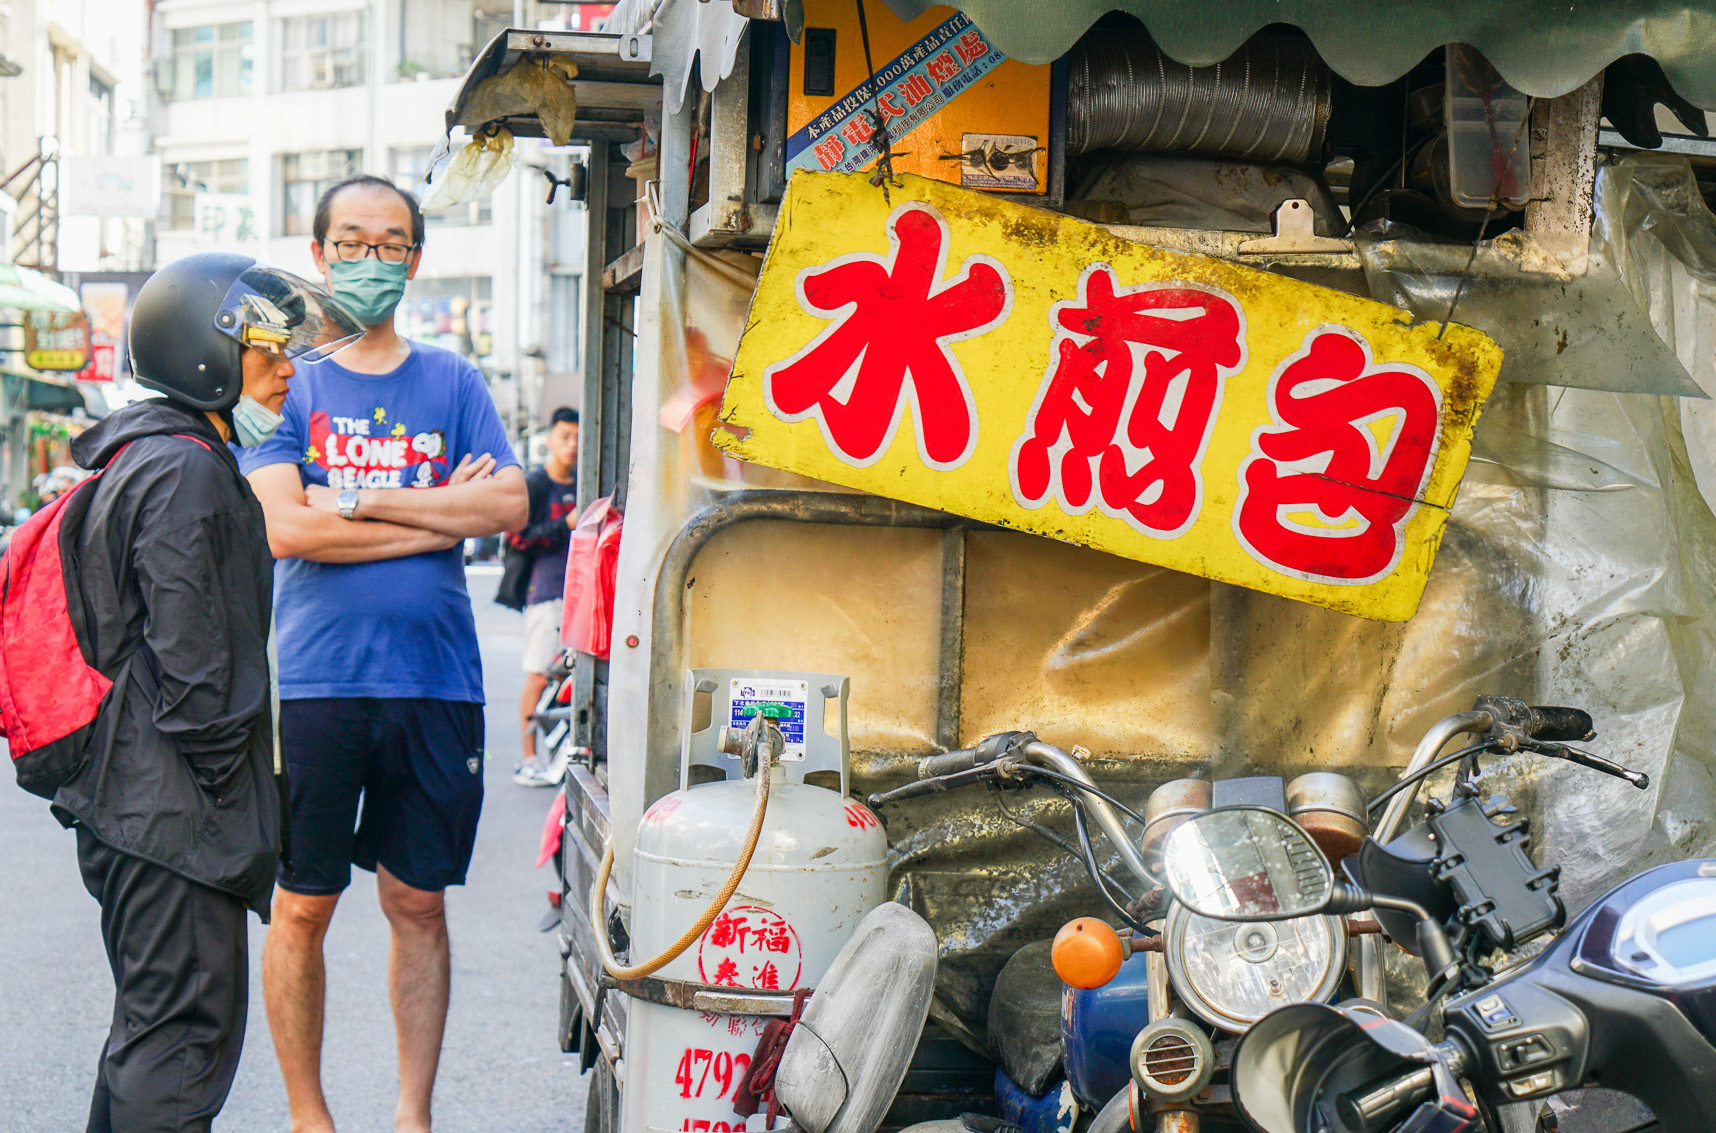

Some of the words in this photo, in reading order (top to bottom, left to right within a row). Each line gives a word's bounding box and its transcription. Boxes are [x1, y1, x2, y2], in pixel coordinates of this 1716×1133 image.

[811, 30, 989, 172] 靜電式油煙處
[765, 202, 1443, 584] 水煎包
[332, 417, 370, 435] THE
[325, 433, 408, 467] LONE
[327, 466, 402, 489] BEAGLE
[711, 912, 790, 954] 新福
